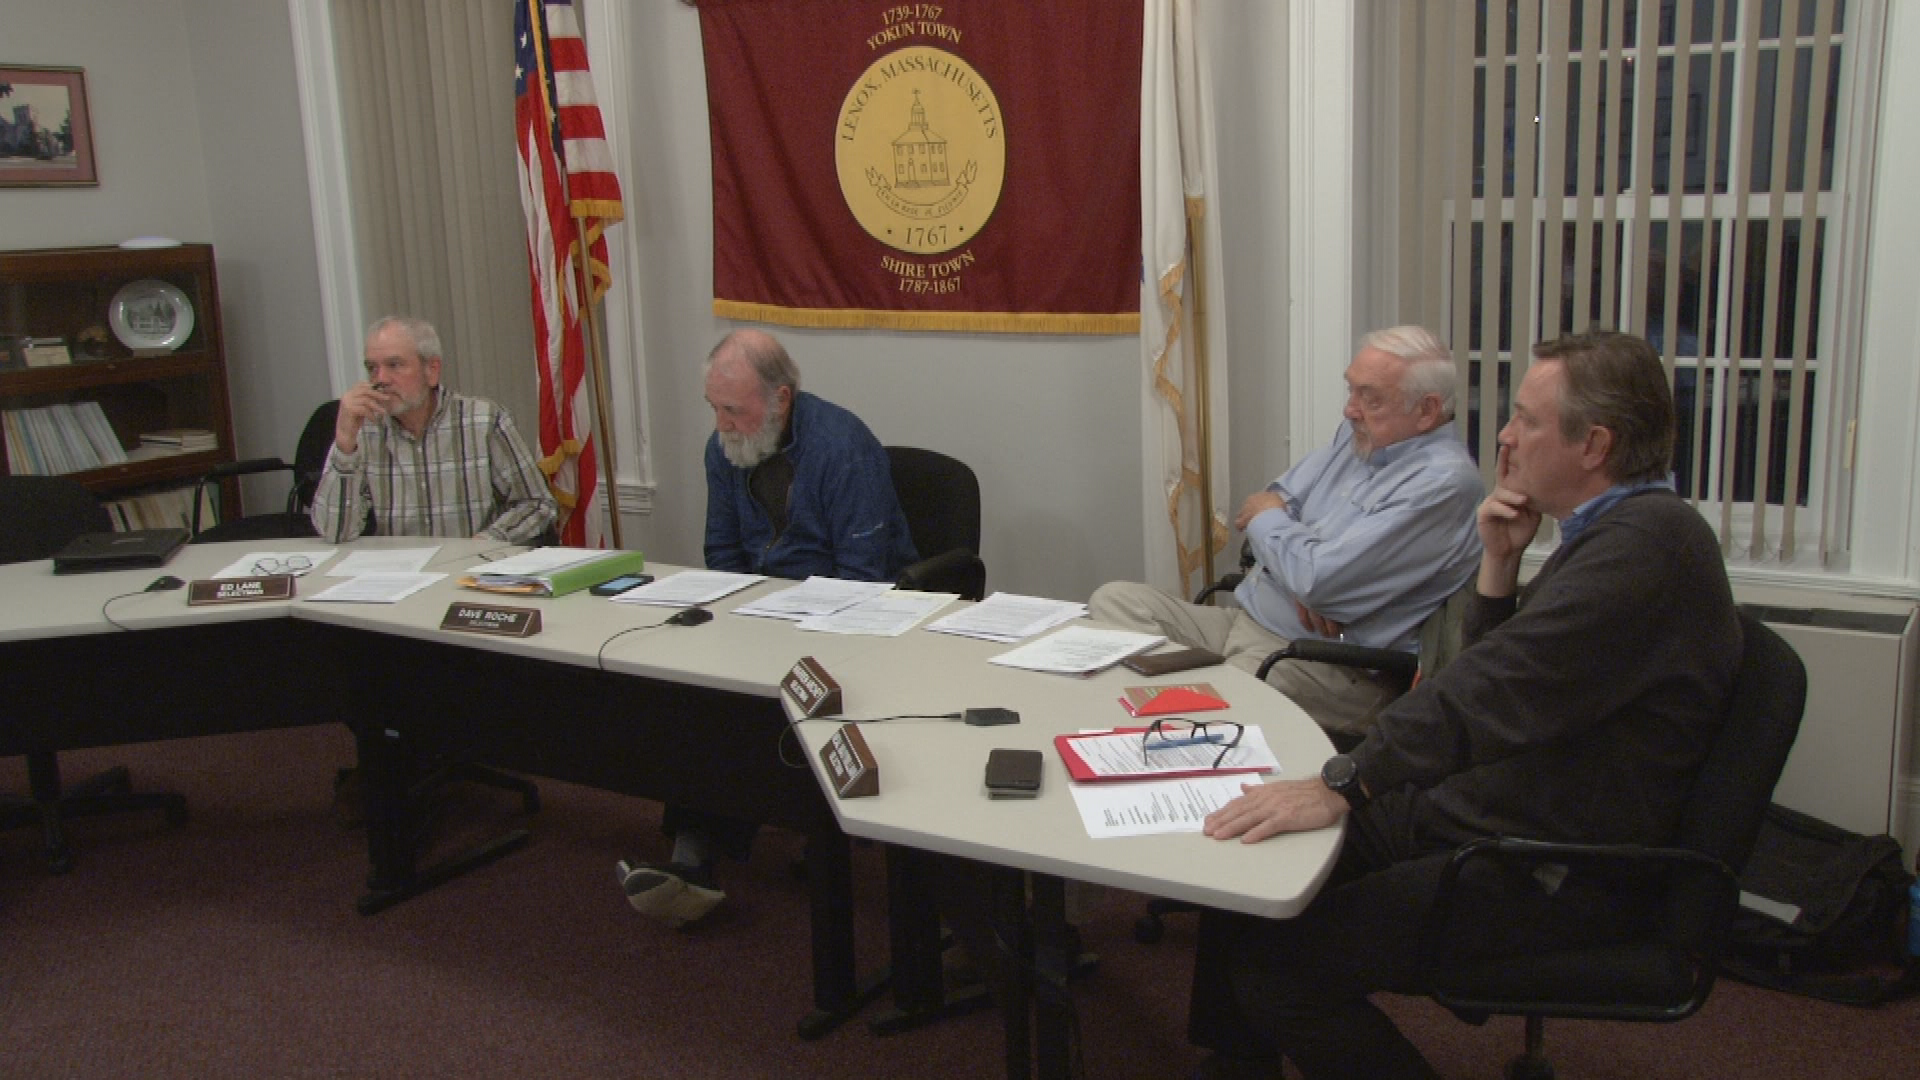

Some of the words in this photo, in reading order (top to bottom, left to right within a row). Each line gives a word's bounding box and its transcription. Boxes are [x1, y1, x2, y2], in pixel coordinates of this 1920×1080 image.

[882, 4, 943, 25] 1739-1767
[867, 22, 915, 50] YOKUN
[917, 22, 962, 44] TOWN
[842, 77, 882, 141] LENOX,
[880, 55, 998, 139] MASSACHUSETTS
[906, 224, 947, 247] 1767
[881, 255, 925, 278] SHIRE
[928, 249, 975, 278] TOWN
[899, 276, 960, 294] 1787-1867
[220, 583, 235, 591] ED
[236, 581, 262, 591] LANE
[458, 608, 483, 619] DAVE
[484, 611, 518, 623] ROCHE
